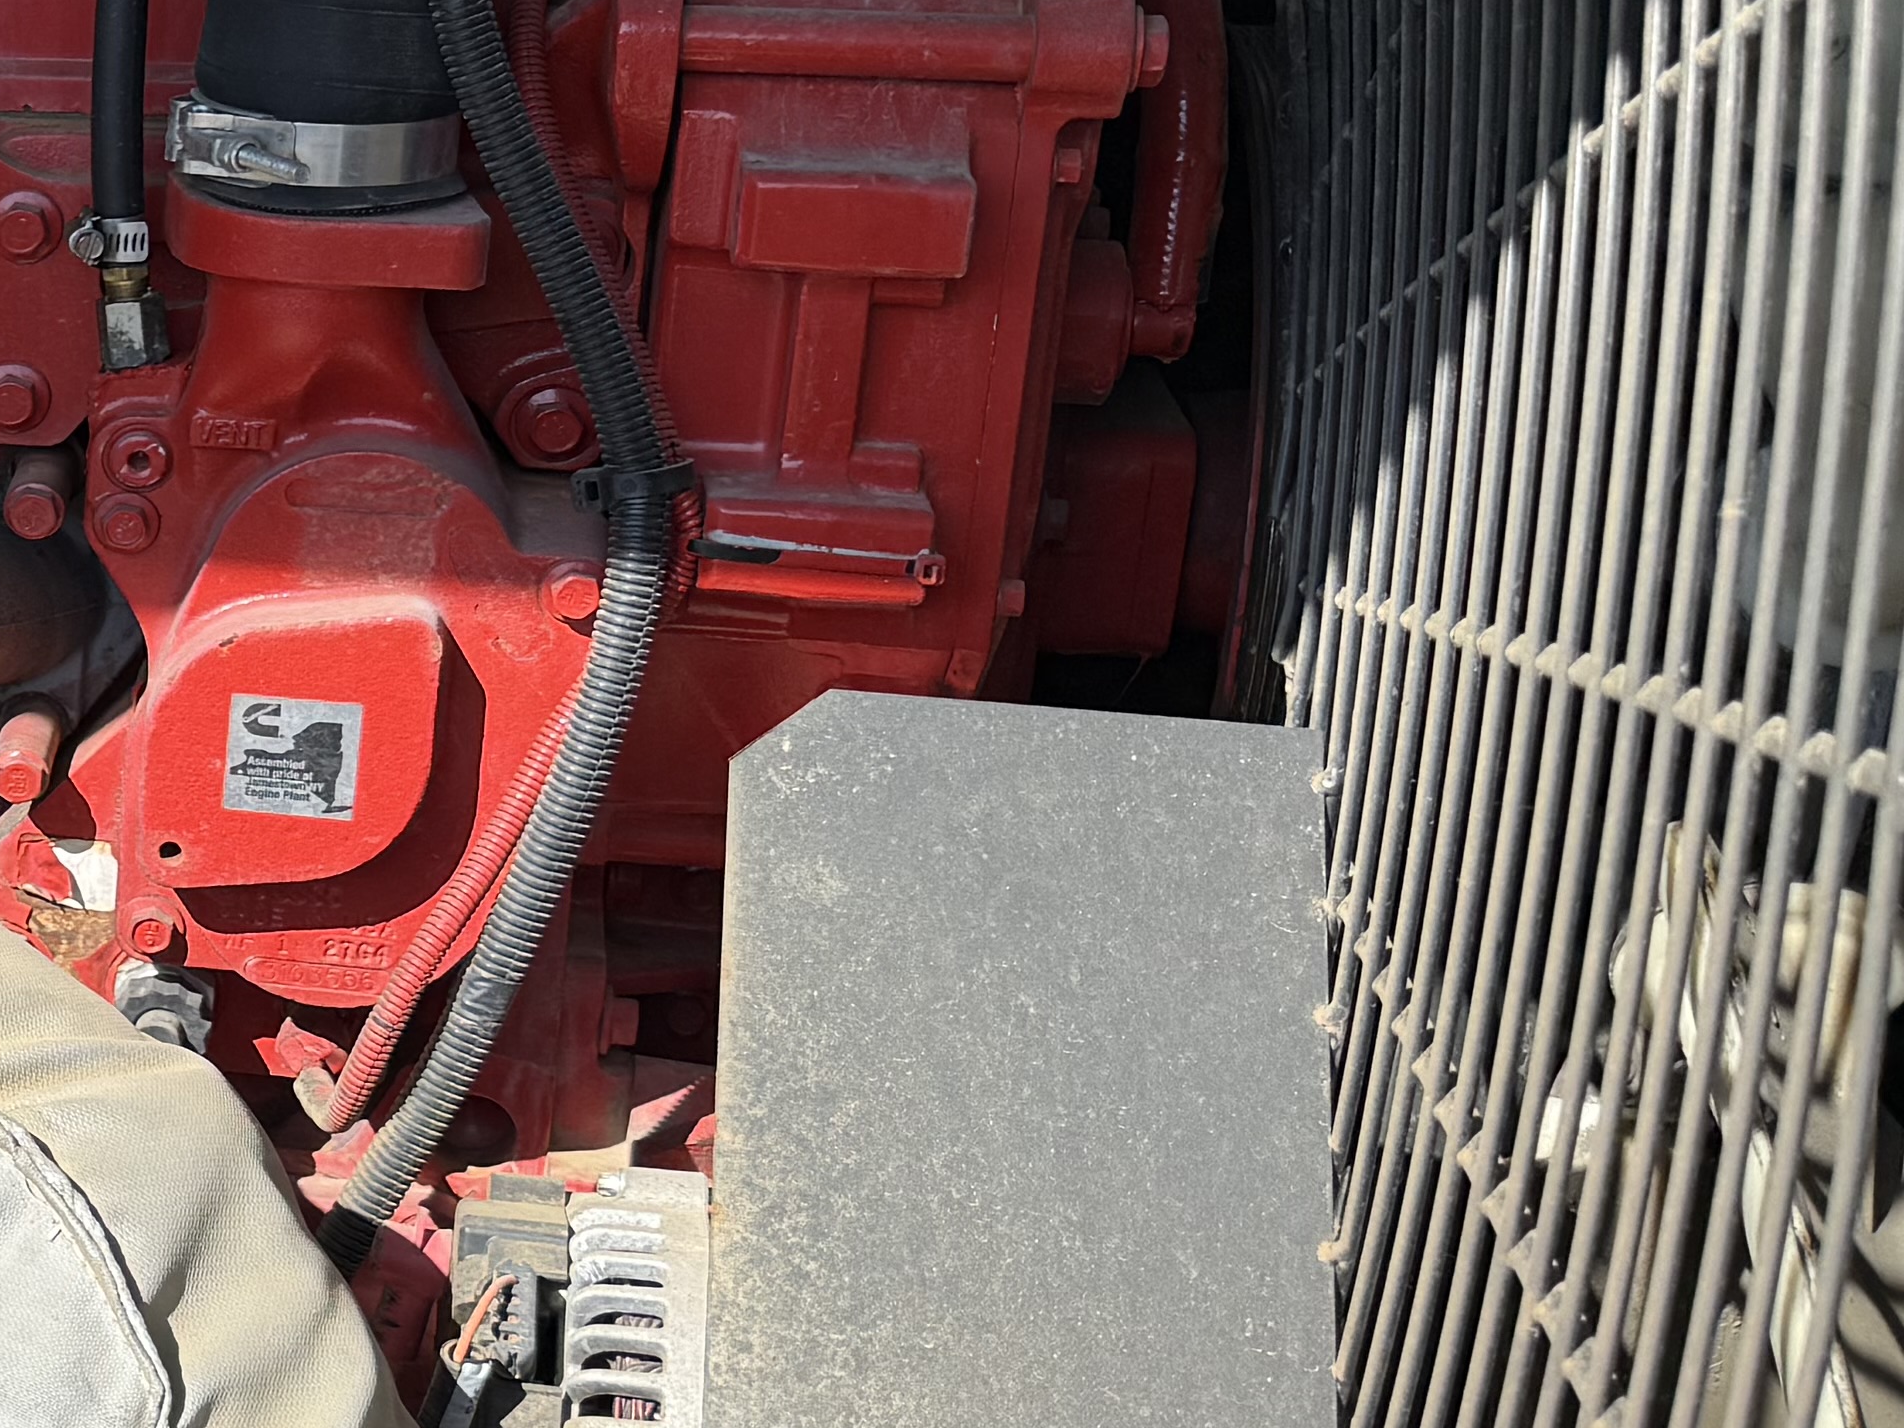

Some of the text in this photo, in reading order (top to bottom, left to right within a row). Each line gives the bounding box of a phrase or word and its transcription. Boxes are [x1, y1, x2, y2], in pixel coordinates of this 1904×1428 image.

[197, 418, 267, 446] VENT
[247, 754, 306, 770] Assembled
[247, 767, 313, 781] with pride at
[246, 776, 306, 791] Jamestown
[245, 786, 311, 802] Engine Plant
